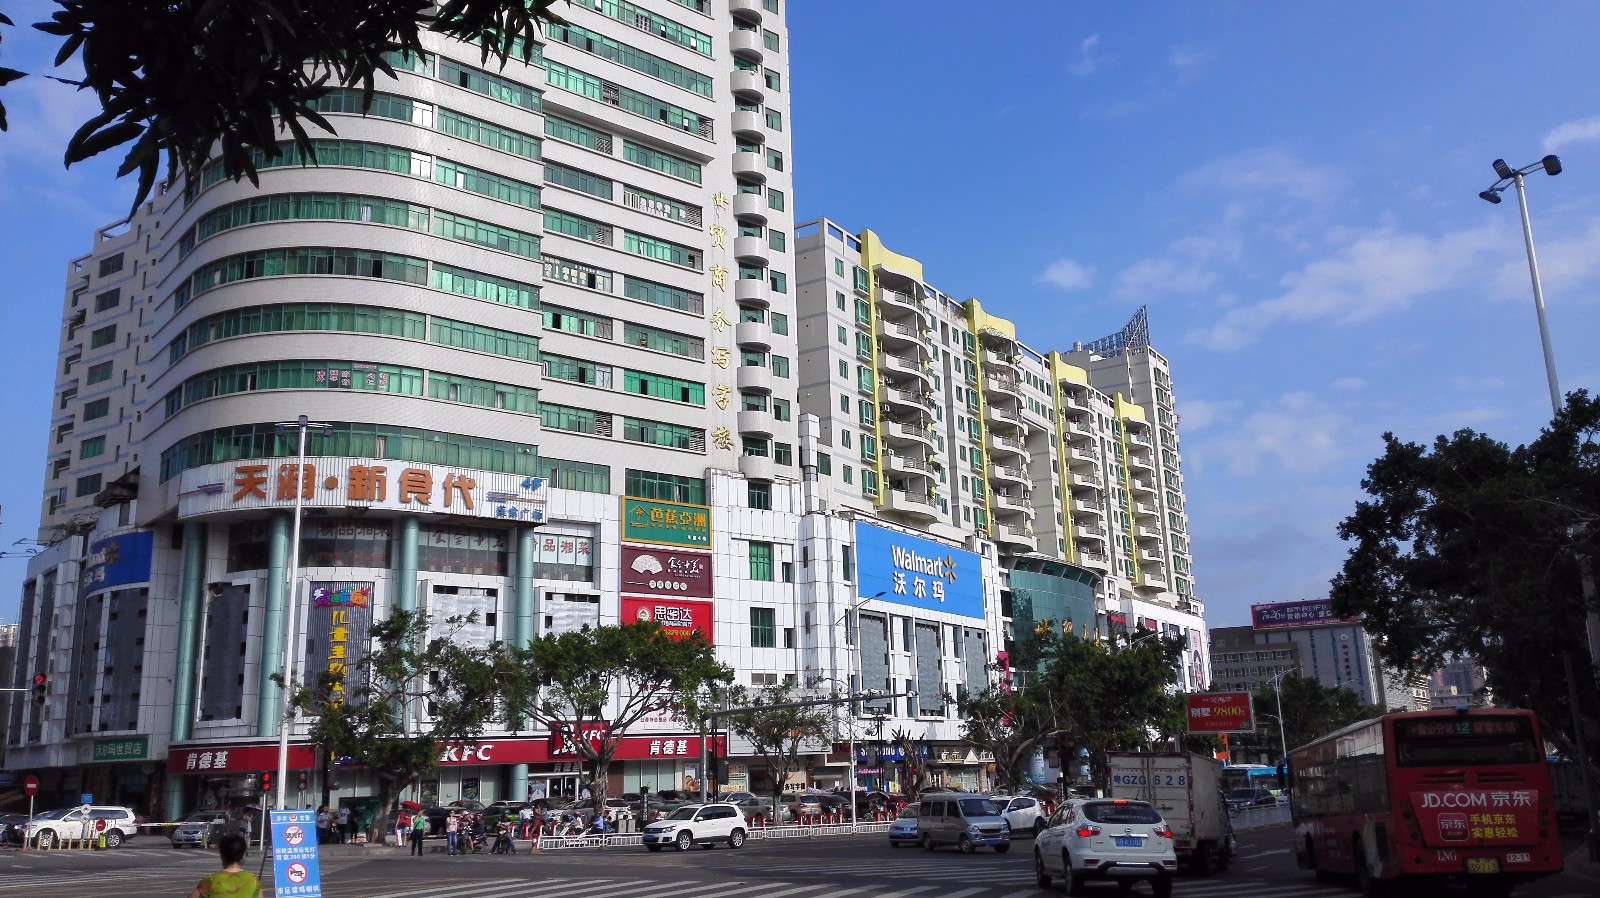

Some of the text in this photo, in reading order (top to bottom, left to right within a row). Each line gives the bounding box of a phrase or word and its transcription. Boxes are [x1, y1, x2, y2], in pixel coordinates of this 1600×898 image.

[709, 191, 734, 451] 世贸商务写字楼
[892, 544, 944, 578] Walmart
[893, 570, 945, 603] 沃尔玛
[1213, 706, 1241, 716] 9800
[1456, 721, 1470, 733] 12
[95, 742, 142, 757] 沃尔玛世贸店
[440, 744, 494, 762] KFC
[650, 739, 687, 756] 肯德基
[186, 750, 229, 770] 肯德基
[1422, 791, 1532, 808] JD.COM 京东
[1441, 819, 1467, 829] 京东
[1470, 814, 1516, 825] 手机京东
[1472, 827, 1519, 838] 实惠轻松
[1437, 850, 1457, 861] LNG
[1507, 854, 1530, 862] 12-11
